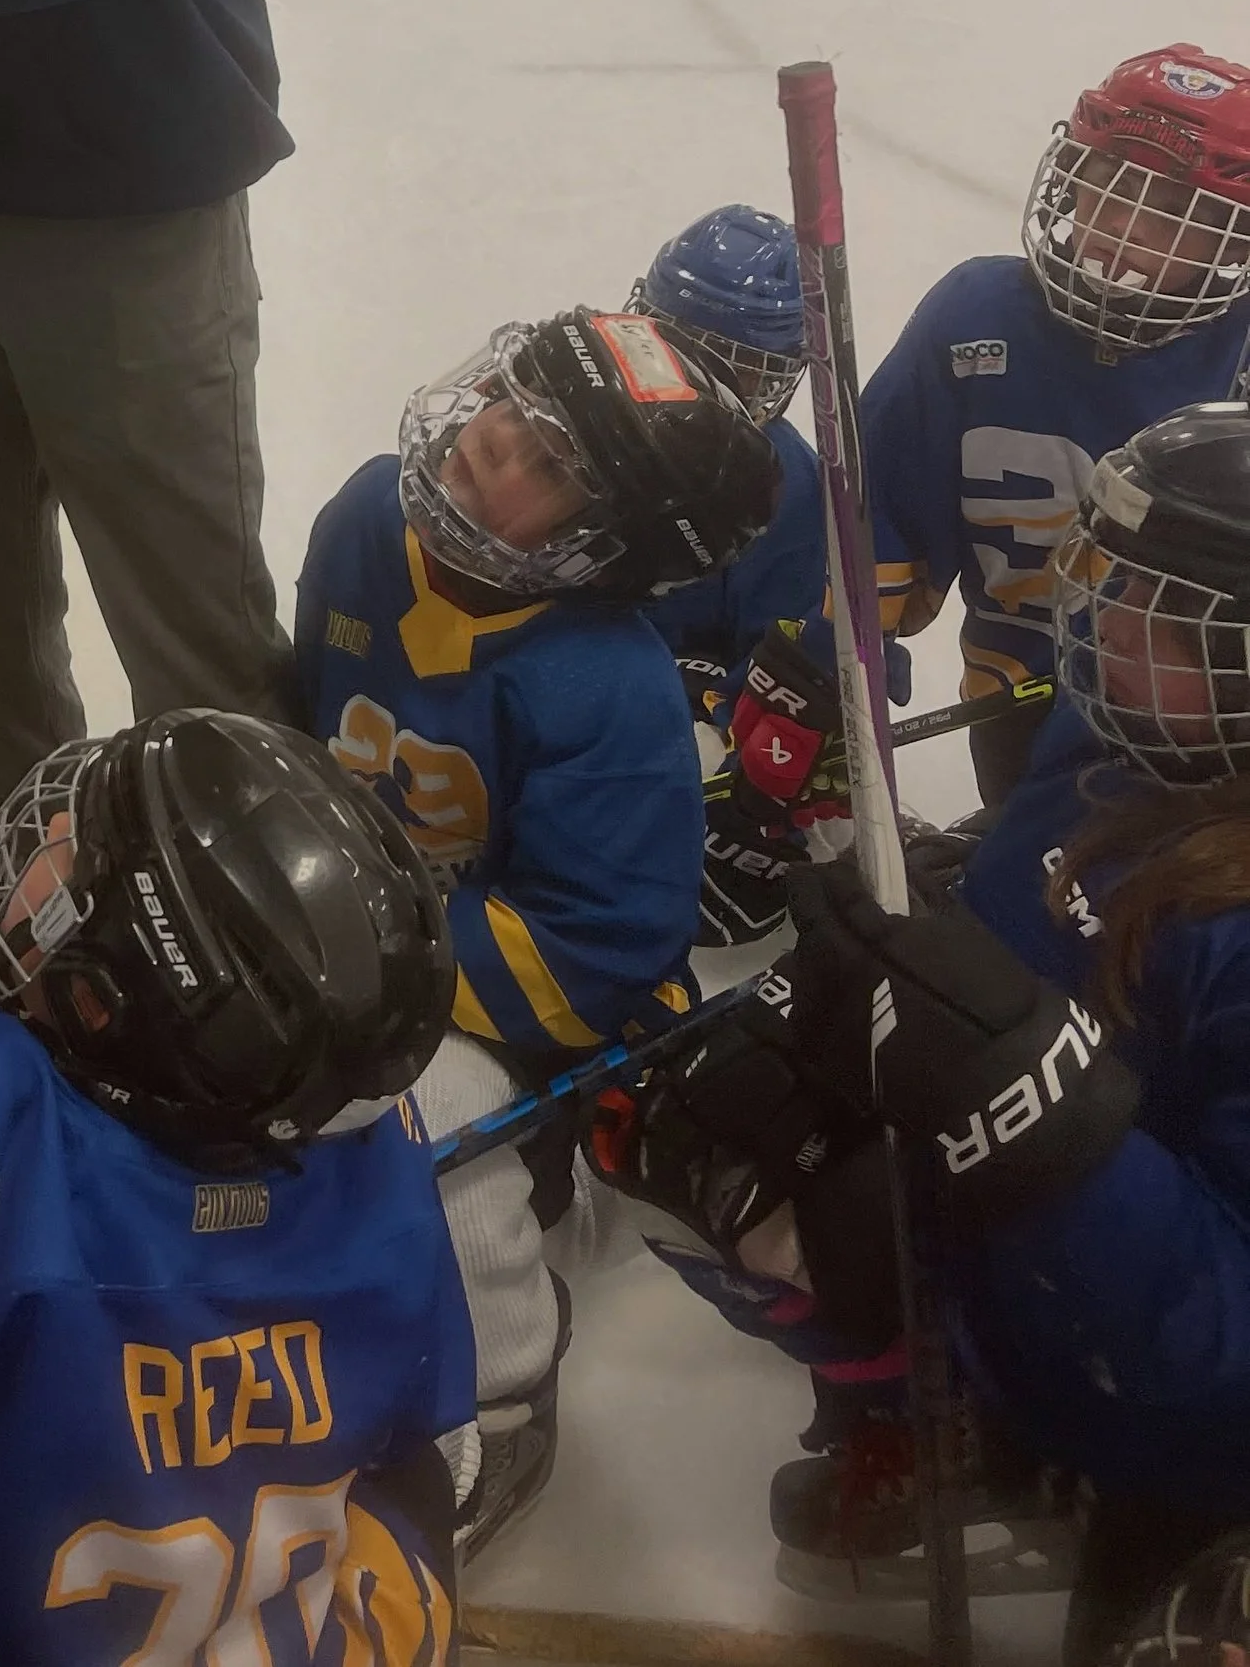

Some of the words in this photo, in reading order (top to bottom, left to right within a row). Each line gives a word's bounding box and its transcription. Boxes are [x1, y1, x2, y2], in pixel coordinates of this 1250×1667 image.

[562, 324, 606, 389] BAUER
[675, 518, 714, 568] BAUER
[133, 871, 199, 990] BAUER
[123, 1319, 334, 1474] REED
